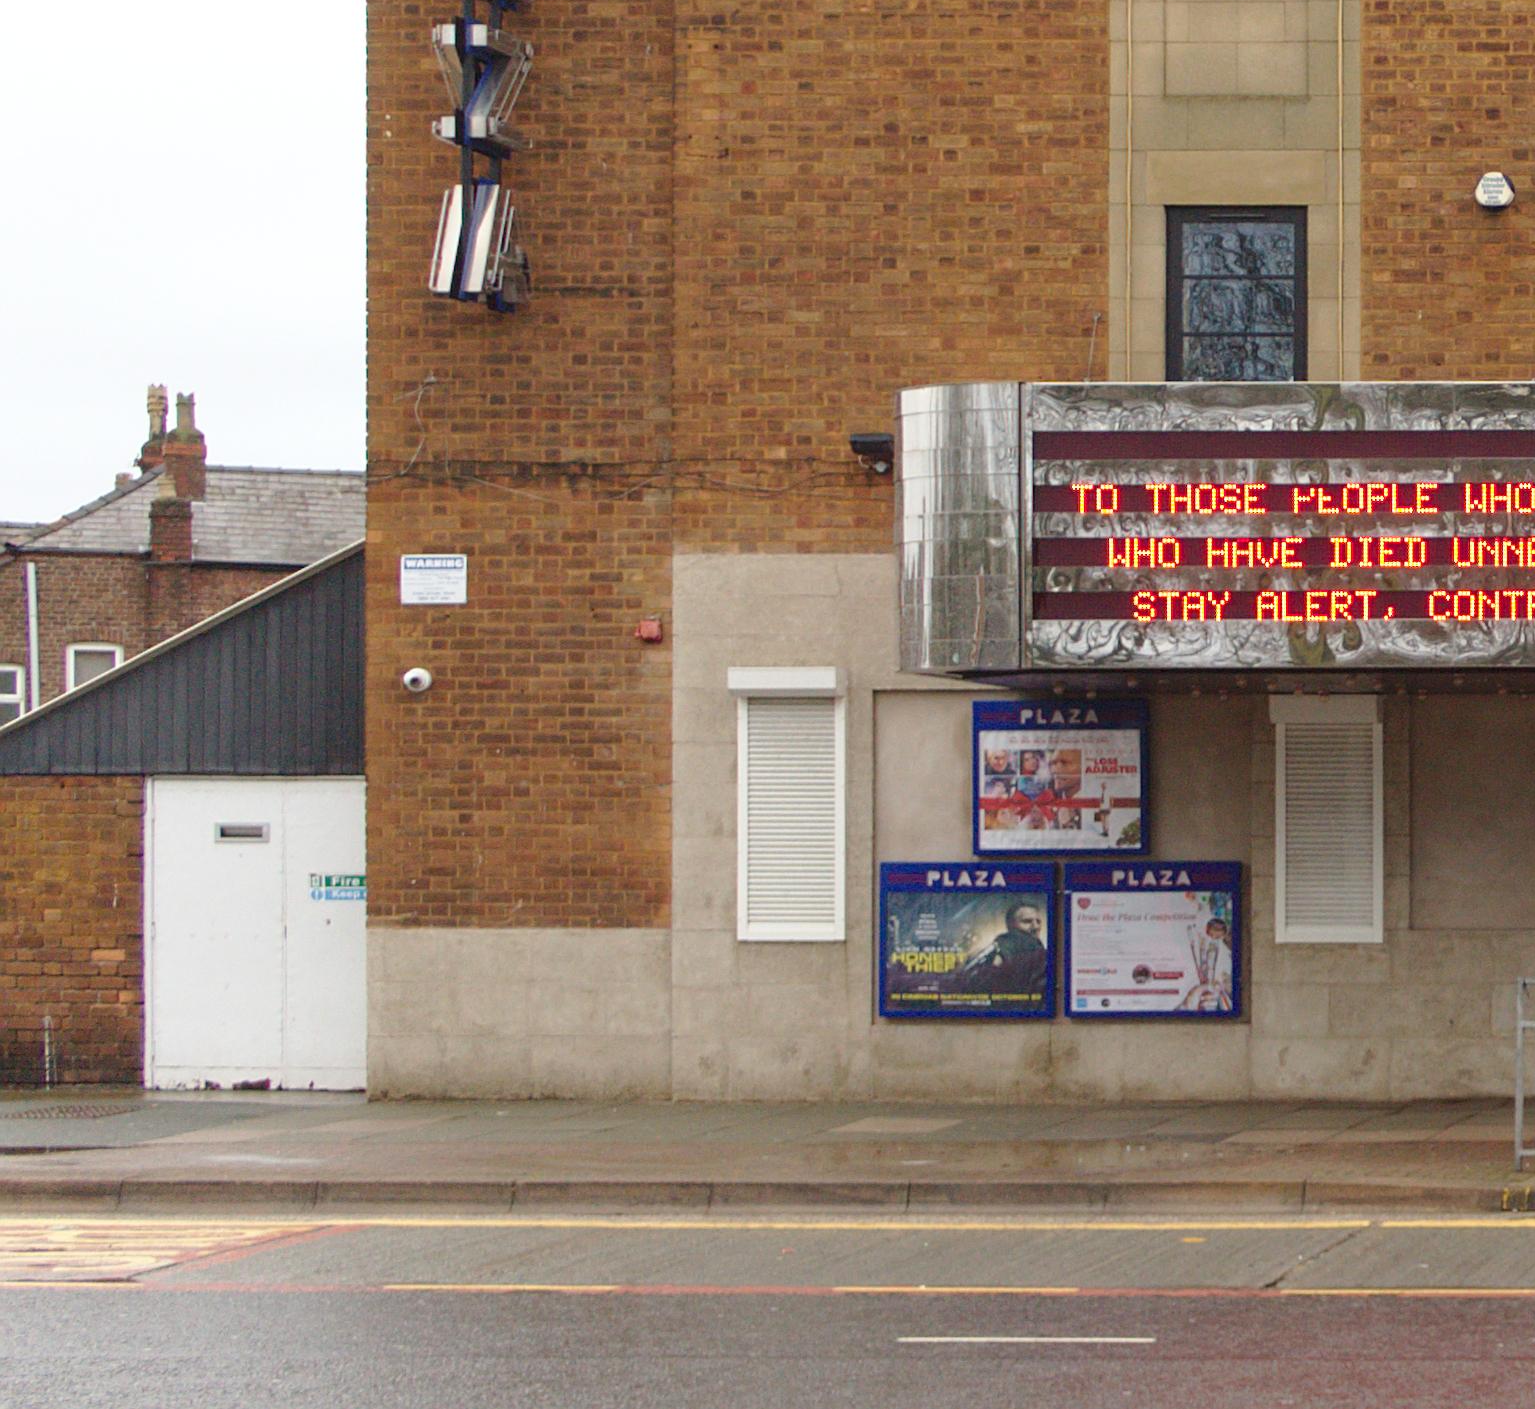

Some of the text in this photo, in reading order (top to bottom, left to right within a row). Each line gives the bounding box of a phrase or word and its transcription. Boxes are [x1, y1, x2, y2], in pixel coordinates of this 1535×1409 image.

[1072, 483, 1120, 515] TO
[1145, 482, 1267, 515] THOSE
[1291, 481, 1438, 515] PEOPLE
[1108, 535, 1180, 569] WHO
[1206, 535, 1303, 569] HAVE
[1330, 534, 1426, 569] DIED
[405, 558, 463, 568] WARNING
[1133, 589, 1231, 623] STAY
[1256, 589, 1395, 623] ALERT,
[1019, 708, 1099, 724] PLAZA
[926, 870, 1006, 887] PLAZA
[1111, 869, 1191, 886] PLAZA
